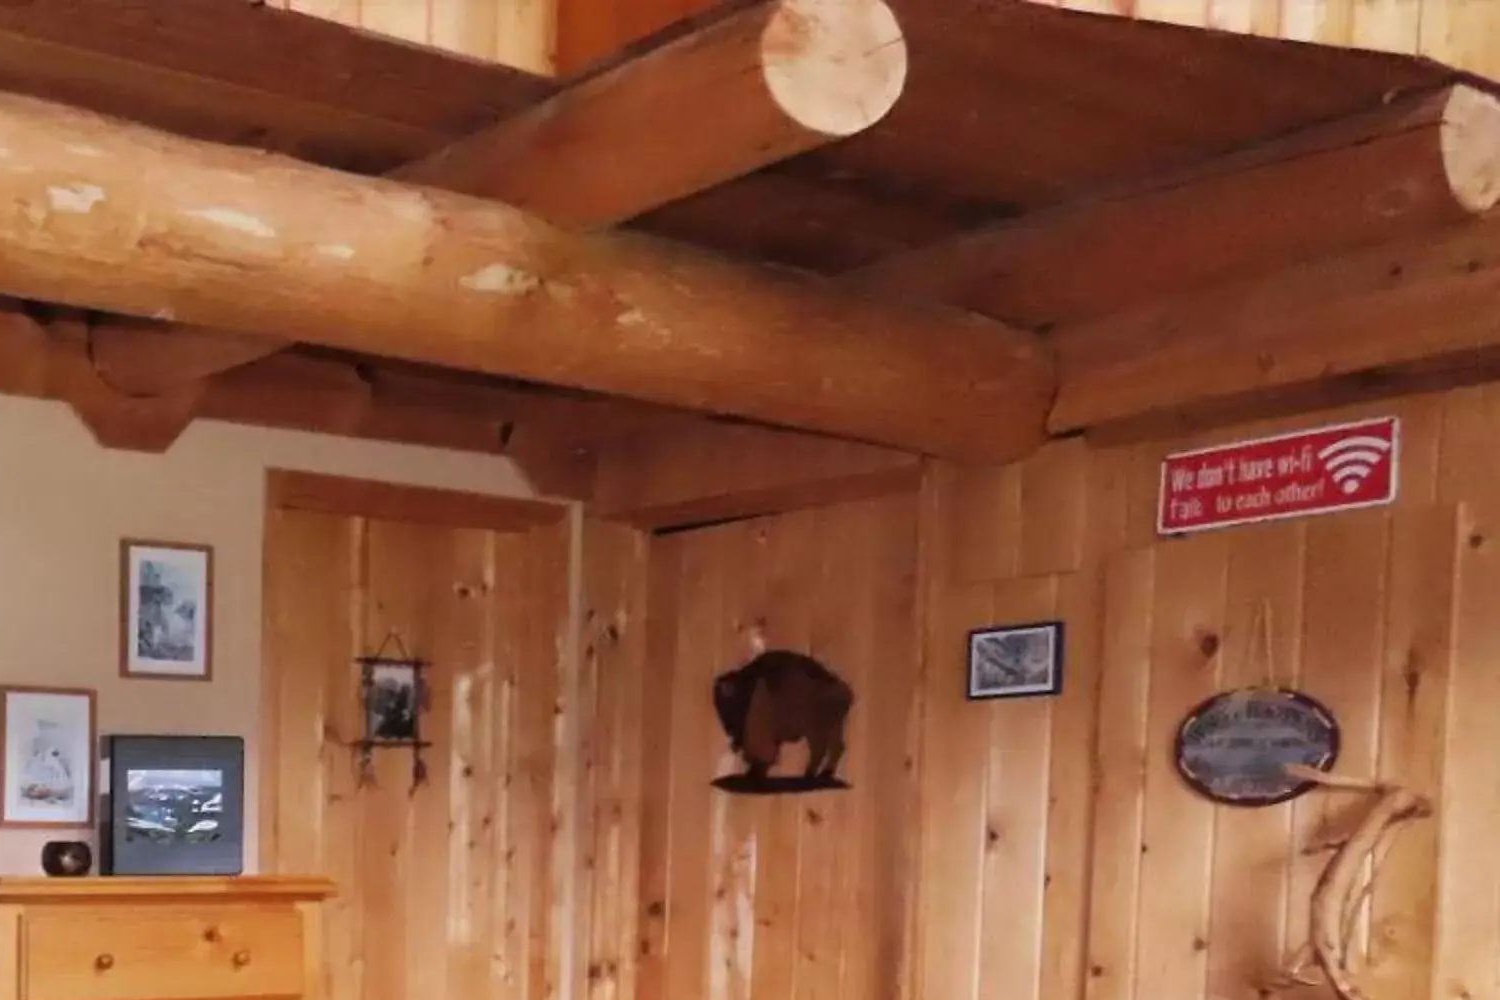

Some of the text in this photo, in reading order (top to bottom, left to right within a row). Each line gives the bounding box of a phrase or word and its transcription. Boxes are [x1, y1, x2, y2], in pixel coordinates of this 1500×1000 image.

[1171, 466, 1195, 492] We
[1197, 460, 1236, 489] don't
[1238, 457, 1274, 480] have
[1215, 494, 1233, 513] to
[1235, 485, 1271, 509] each
